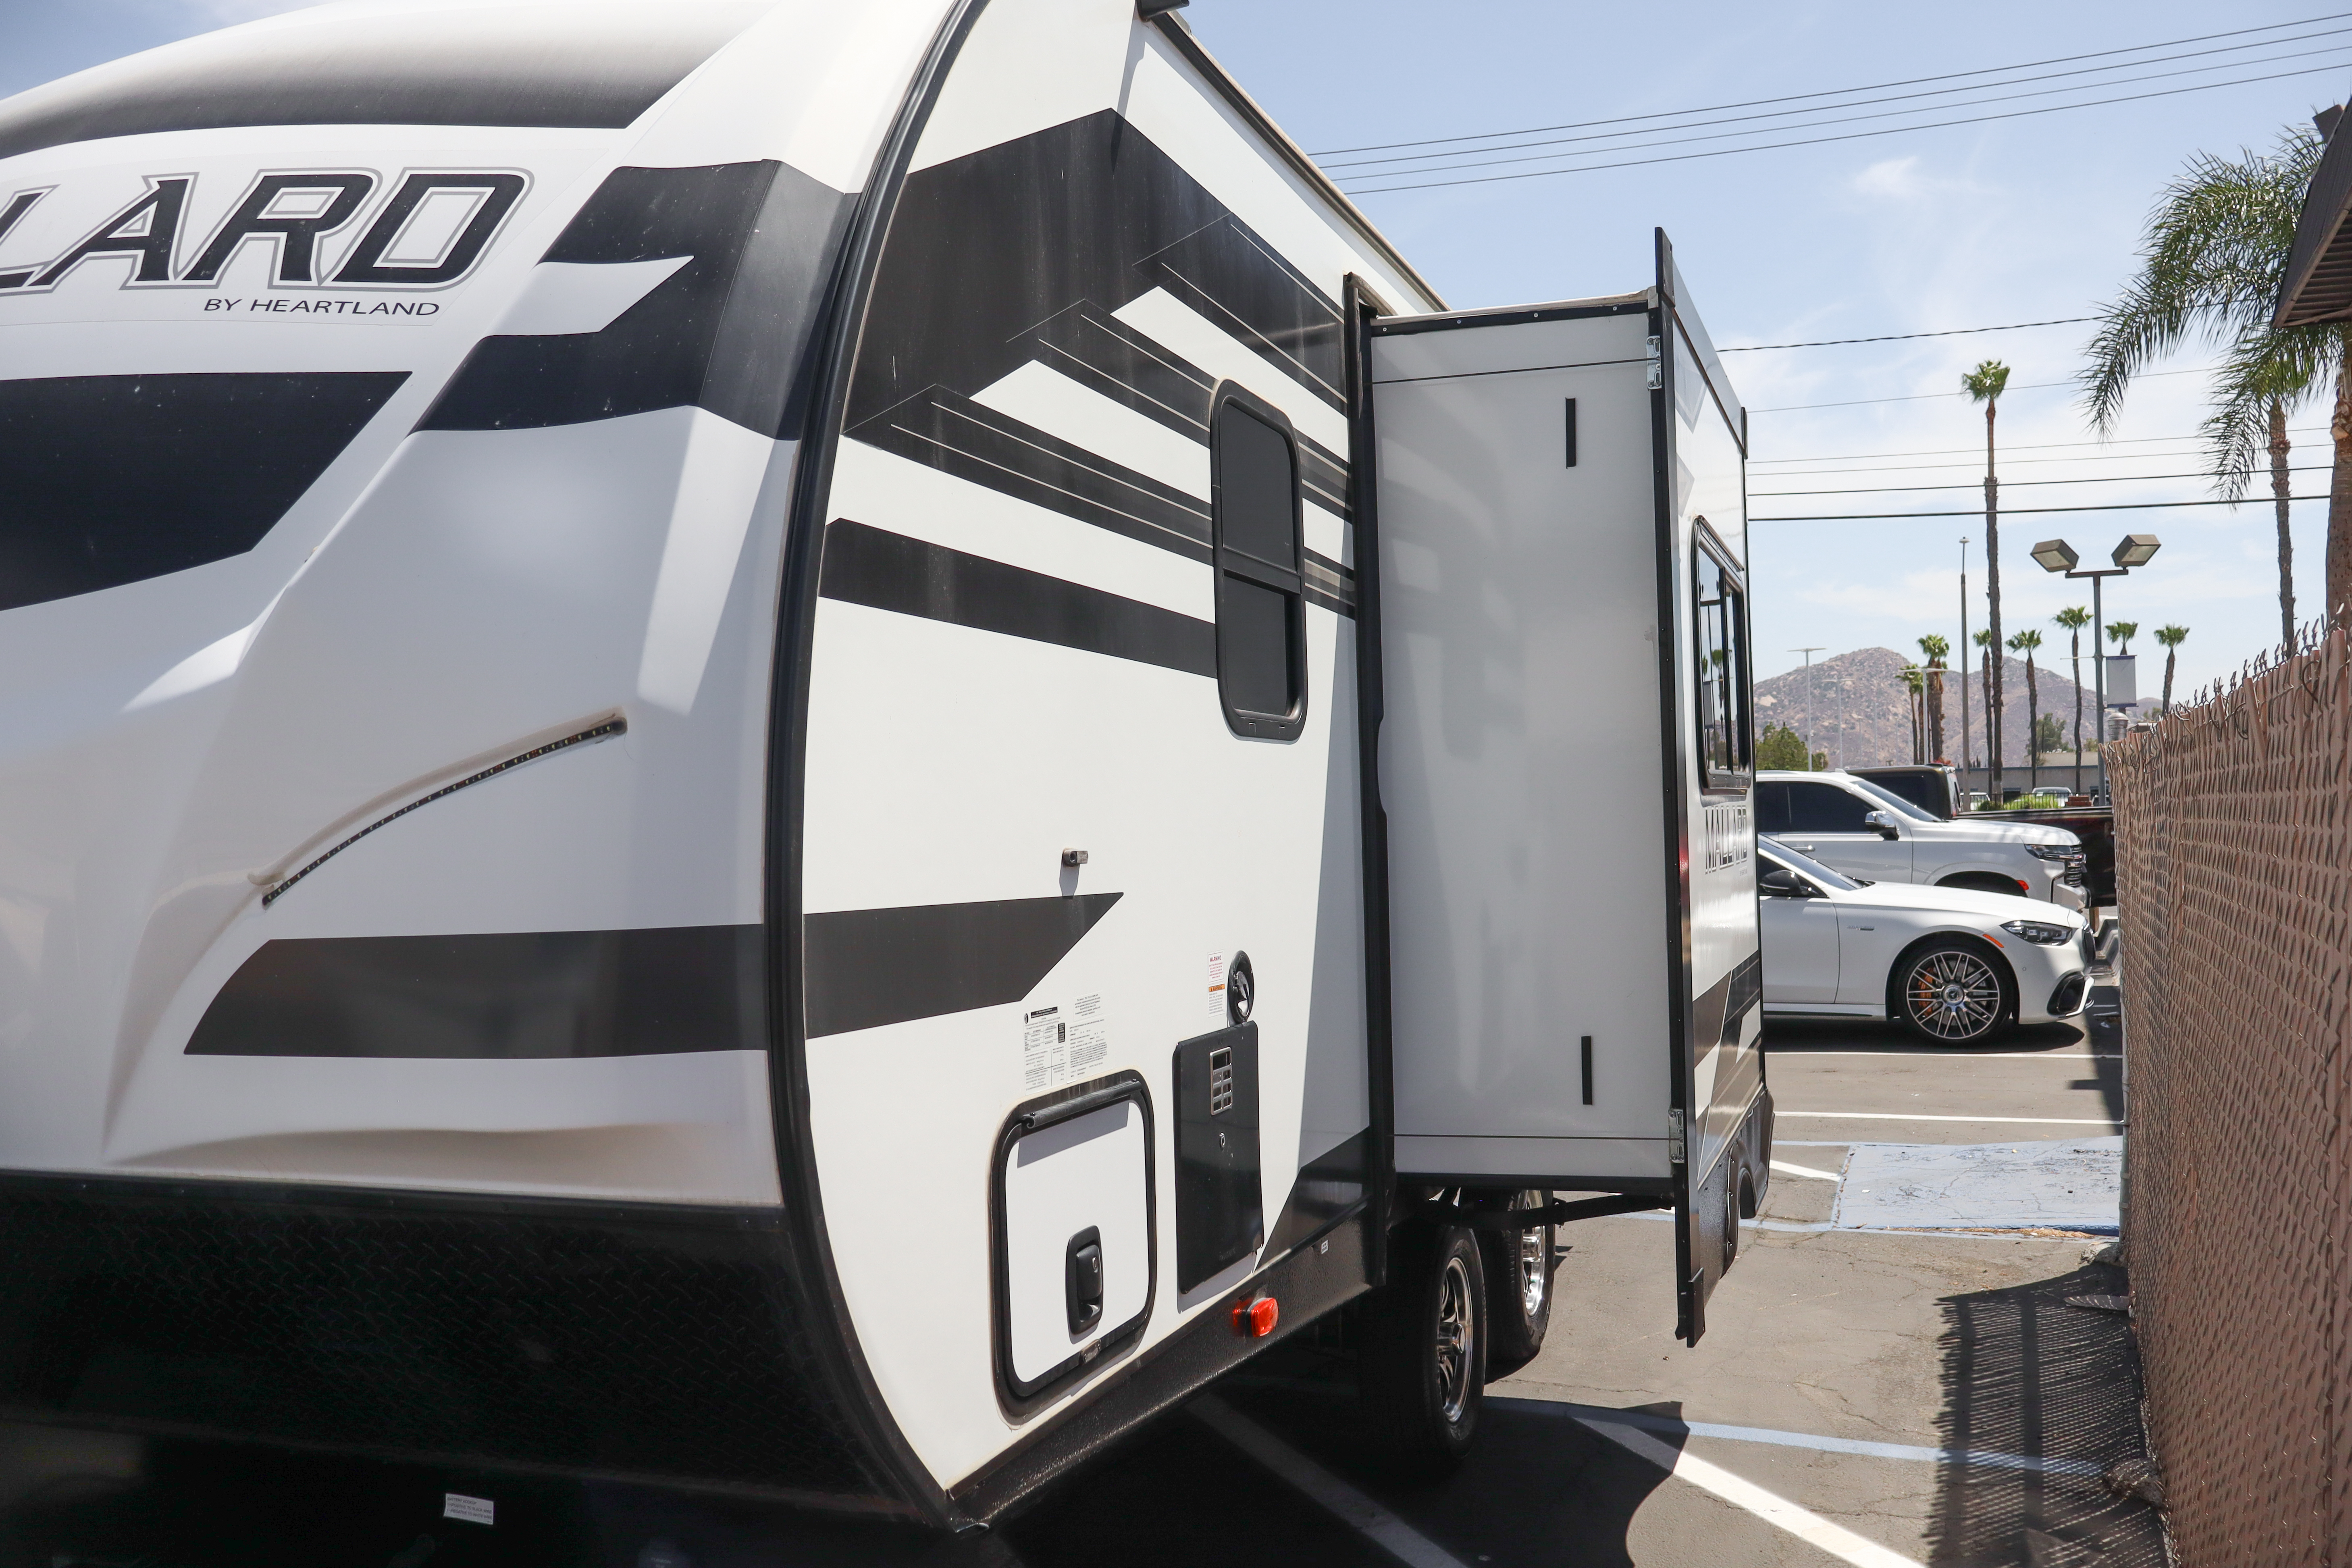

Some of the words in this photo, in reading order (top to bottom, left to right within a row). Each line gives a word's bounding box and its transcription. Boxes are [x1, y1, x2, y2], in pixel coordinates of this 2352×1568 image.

[204, 299, 242, 311] BY
[250, 299, 440, 316] HEARTLAND
[1705, 805, 1747, 874] MALLARD
